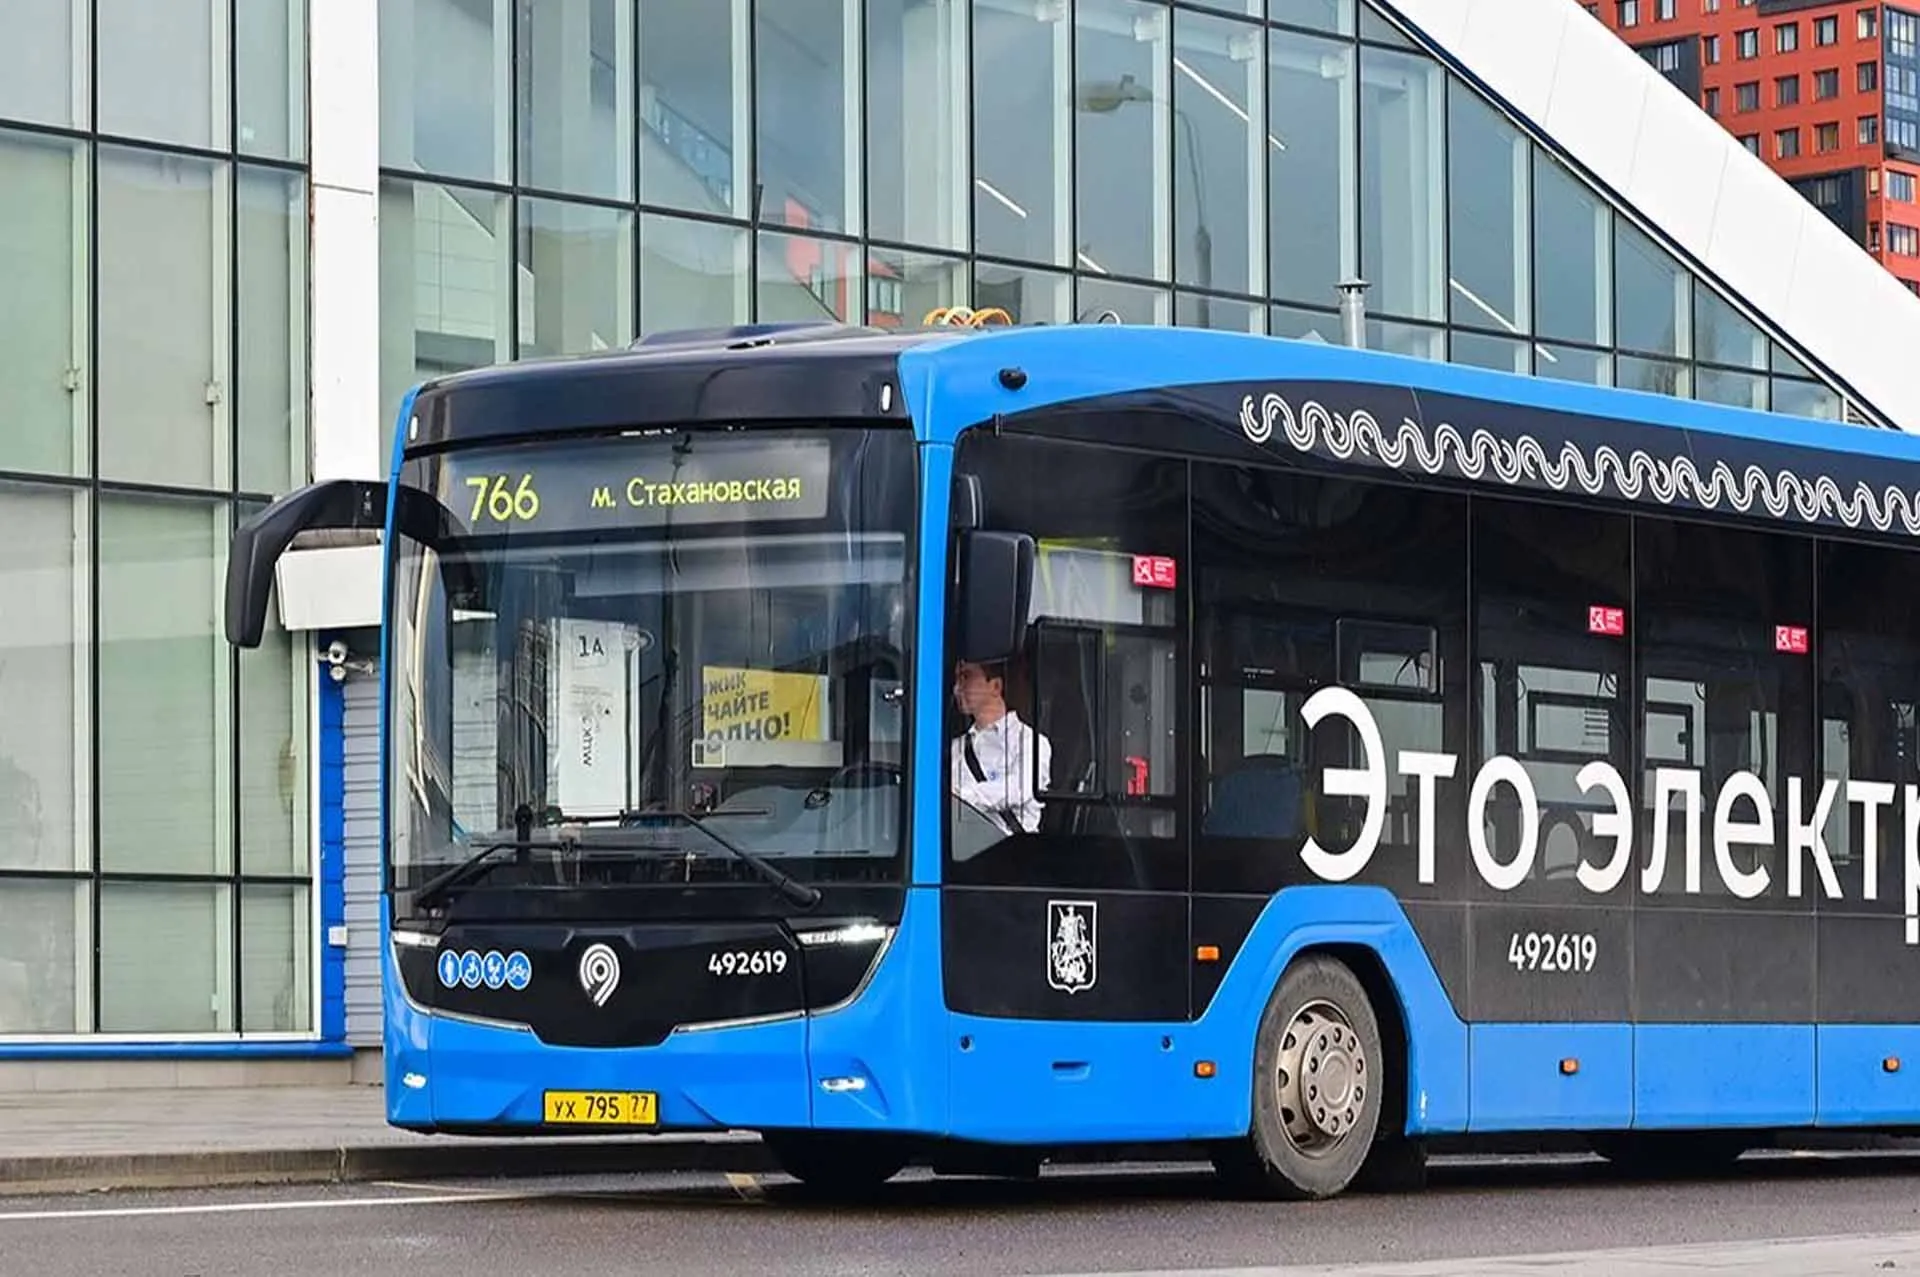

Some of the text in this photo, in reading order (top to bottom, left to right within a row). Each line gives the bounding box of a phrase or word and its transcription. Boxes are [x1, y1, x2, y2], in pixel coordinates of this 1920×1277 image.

[466, 474, 539, 522] 766
[591, 477, 801, 509] м. Стахановская
[1300, 685, 1540, 891] Это
[708, 950, 787, 976] 492619
[1508, 931, 1597, 973] 492619
[584, 1095, 620, 1120] 795
[630, 1095, 649, 1114] 77
